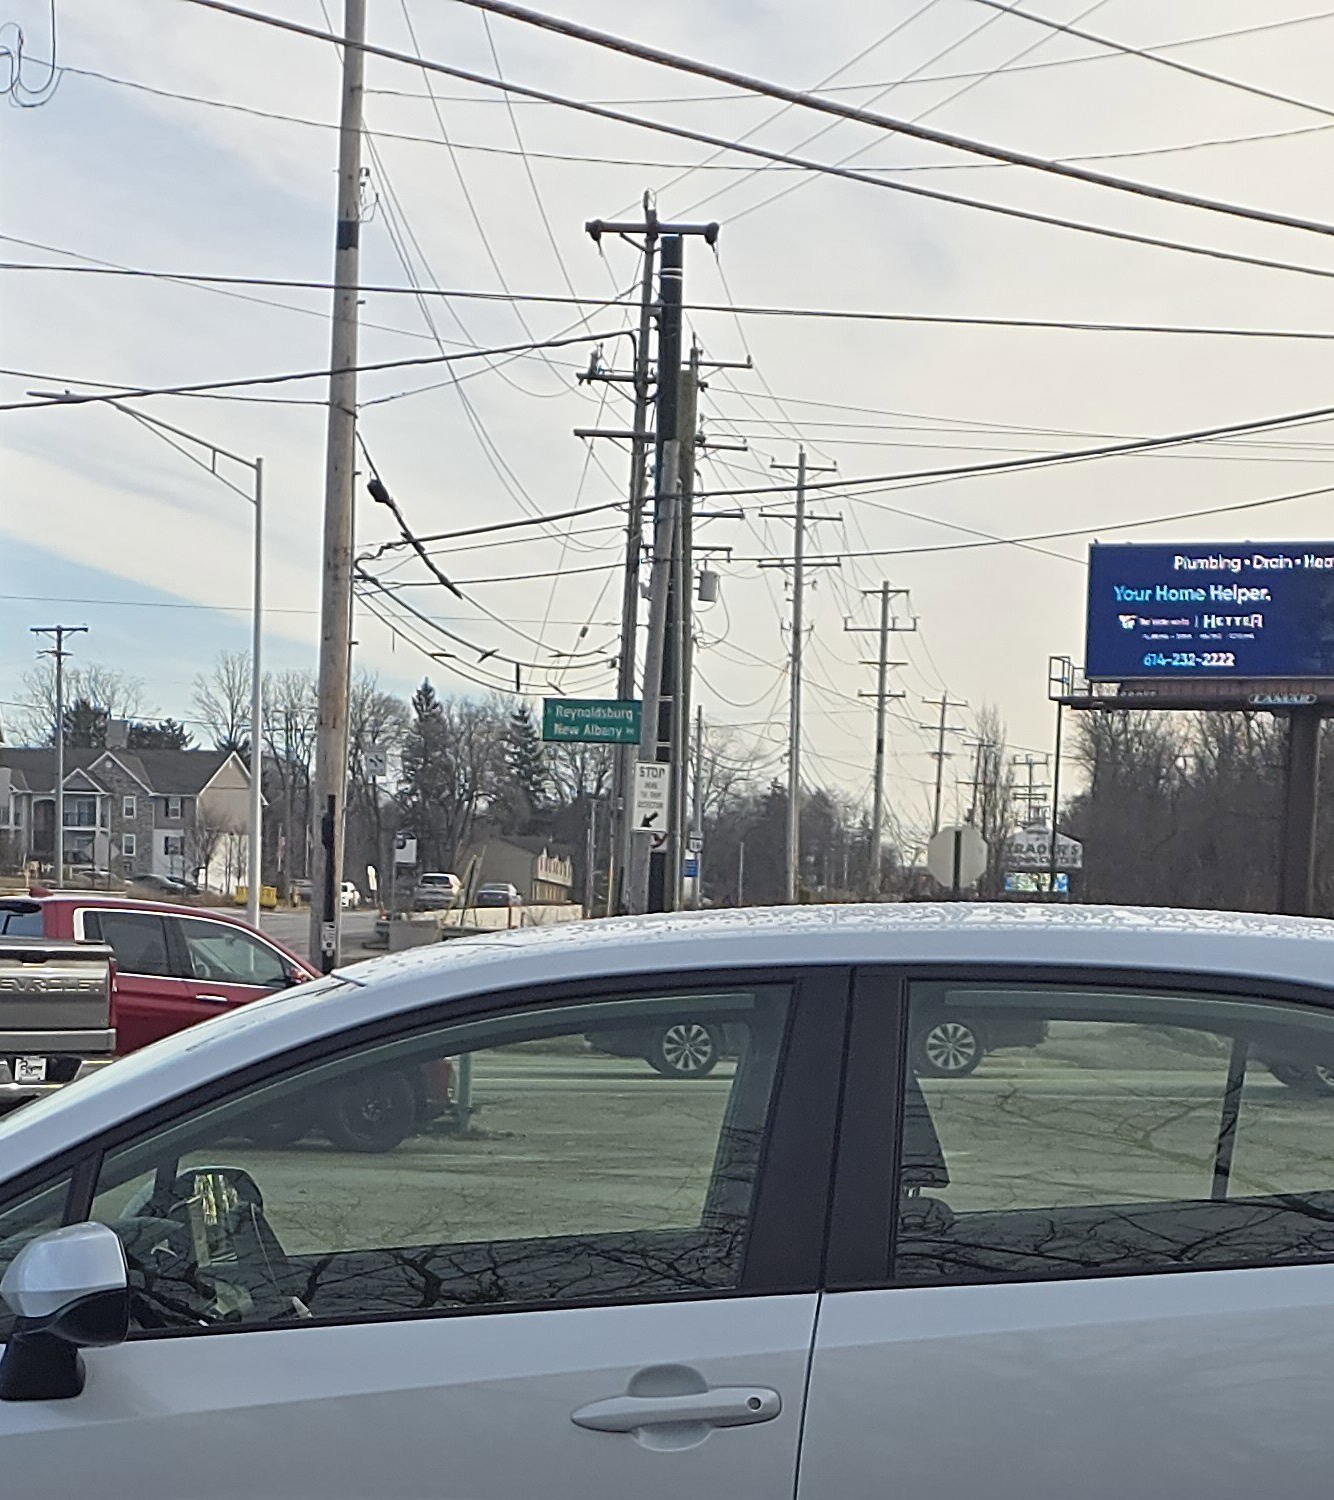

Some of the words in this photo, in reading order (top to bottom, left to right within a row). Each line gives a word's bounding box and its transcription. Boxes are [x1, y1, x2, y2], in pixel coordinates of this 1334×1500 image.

[1174, 553, 1242, 573] Plumbing
[1252, 554, 1293, 570] Drain
[1113, 585, 1153, 601] Your
[1155, 585, 1207, 601] Home
[1209, 583, 1272, 604] Helper.
[555, 704, 634, 723] Reynoldsburg
[553, 722, 579, 736] New
[583, 722, 623, 739] Albany
[639, 765, 666, 779] STOP
